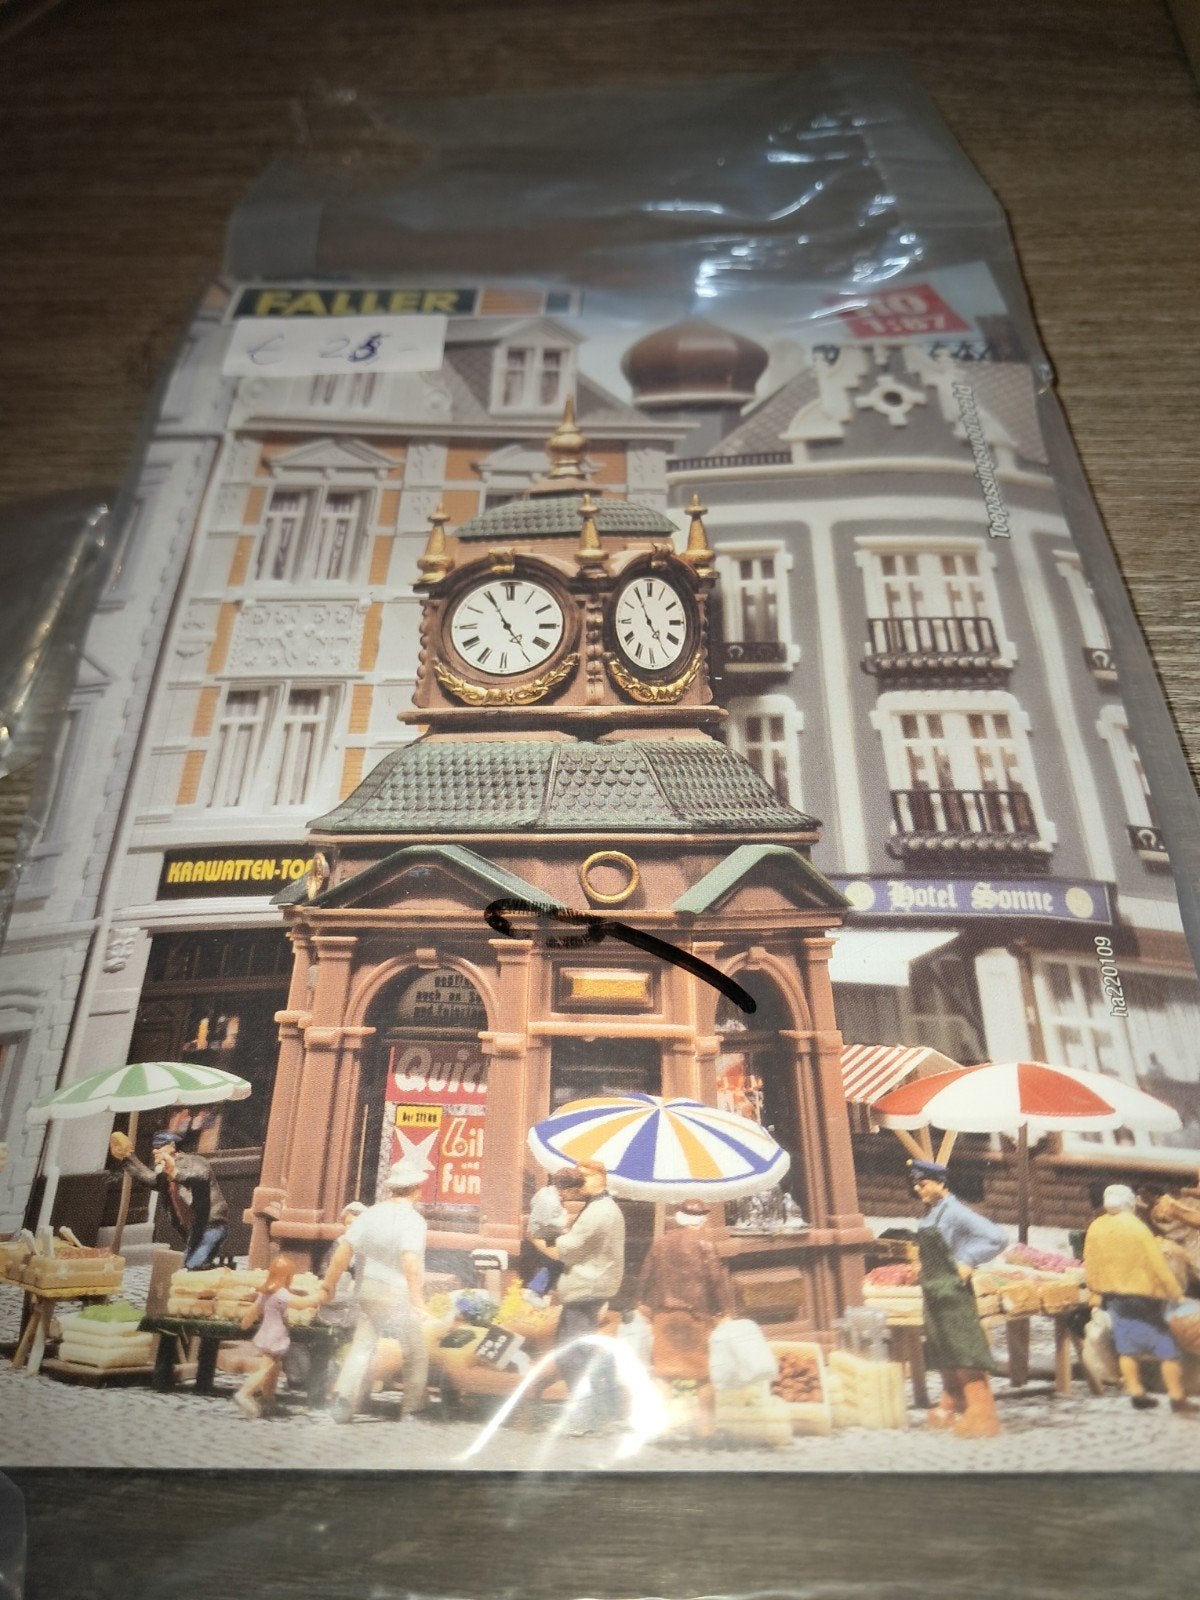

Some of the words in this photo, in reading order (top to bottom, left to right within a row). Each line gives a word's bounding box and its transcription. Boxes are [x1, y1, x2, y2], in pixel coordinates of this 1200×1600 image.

[253, 288, 460, 317] FALLER
[952, 383, 1011, 539] Toepassingsvoorbeeld
[887, 879, 959, 913] Hotel
[971, 881, 1054, 913] Sonne
[1093, 935, 1129, 1018] ha220109
